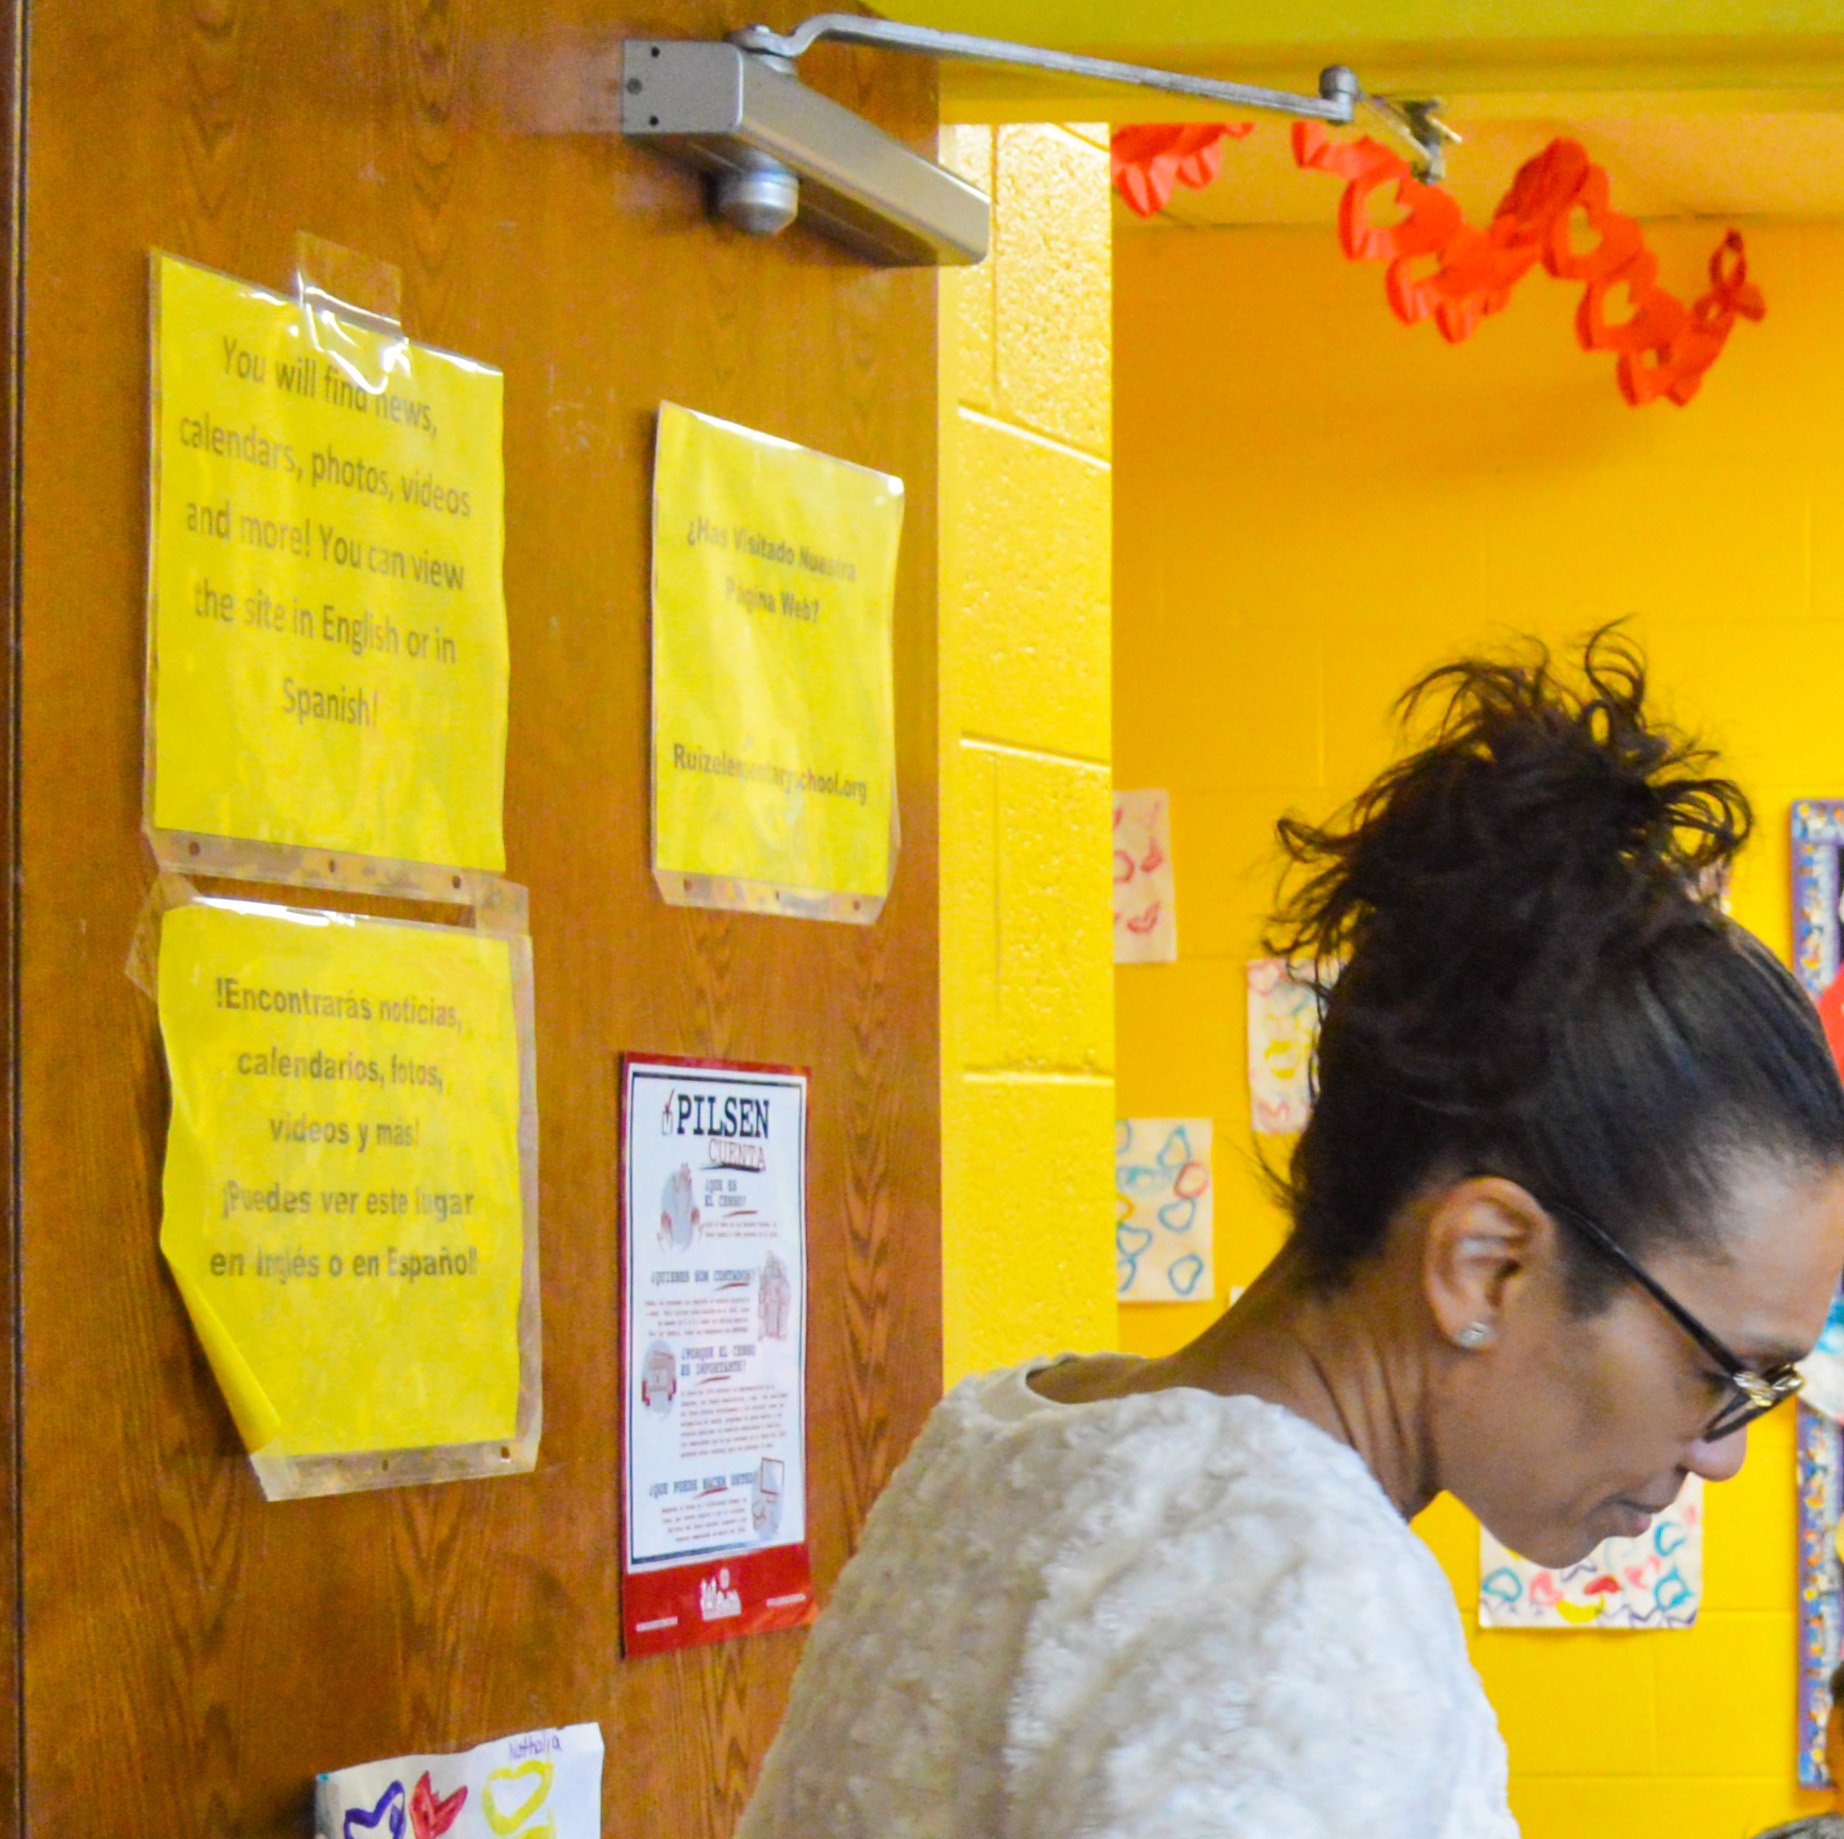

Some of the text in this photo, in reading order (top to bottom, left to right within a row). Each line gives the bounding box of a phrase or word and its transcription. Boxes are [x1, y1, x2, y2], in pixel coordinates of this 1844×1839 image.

[223, 335, 438, 440] You will find news,
[179, 413, 471, 519] calendars, photos, videos
[187, 499, 465, 592] and more! You can view
[732, 525, 795, 566] Visitado
[195, 576, 457, 665] the site in English or in
[780, 590, 821, 624] Web?
[282, 677, 378, 728] Spanish!
[380, 999, 463, 1034] noticias,
[238, 1046, 444, 1094] calendarios, fotos,
[358, 1122, 369, 1153] y
[677, 1093, 770, 1140] PILSEN
[708, 1137, 766, 1172] CUENTA
[321, 1190, 358, 1216] ver
[366, 1187, 408, 1216] este
[414, 1185, 475, 1222] lugar
[210, 1252, 244, 1277] en
[256, 1246, 320, 1286] Inglés
[329, 1255, 343, 1278] o
[353, 1253, 380, 1278] en
